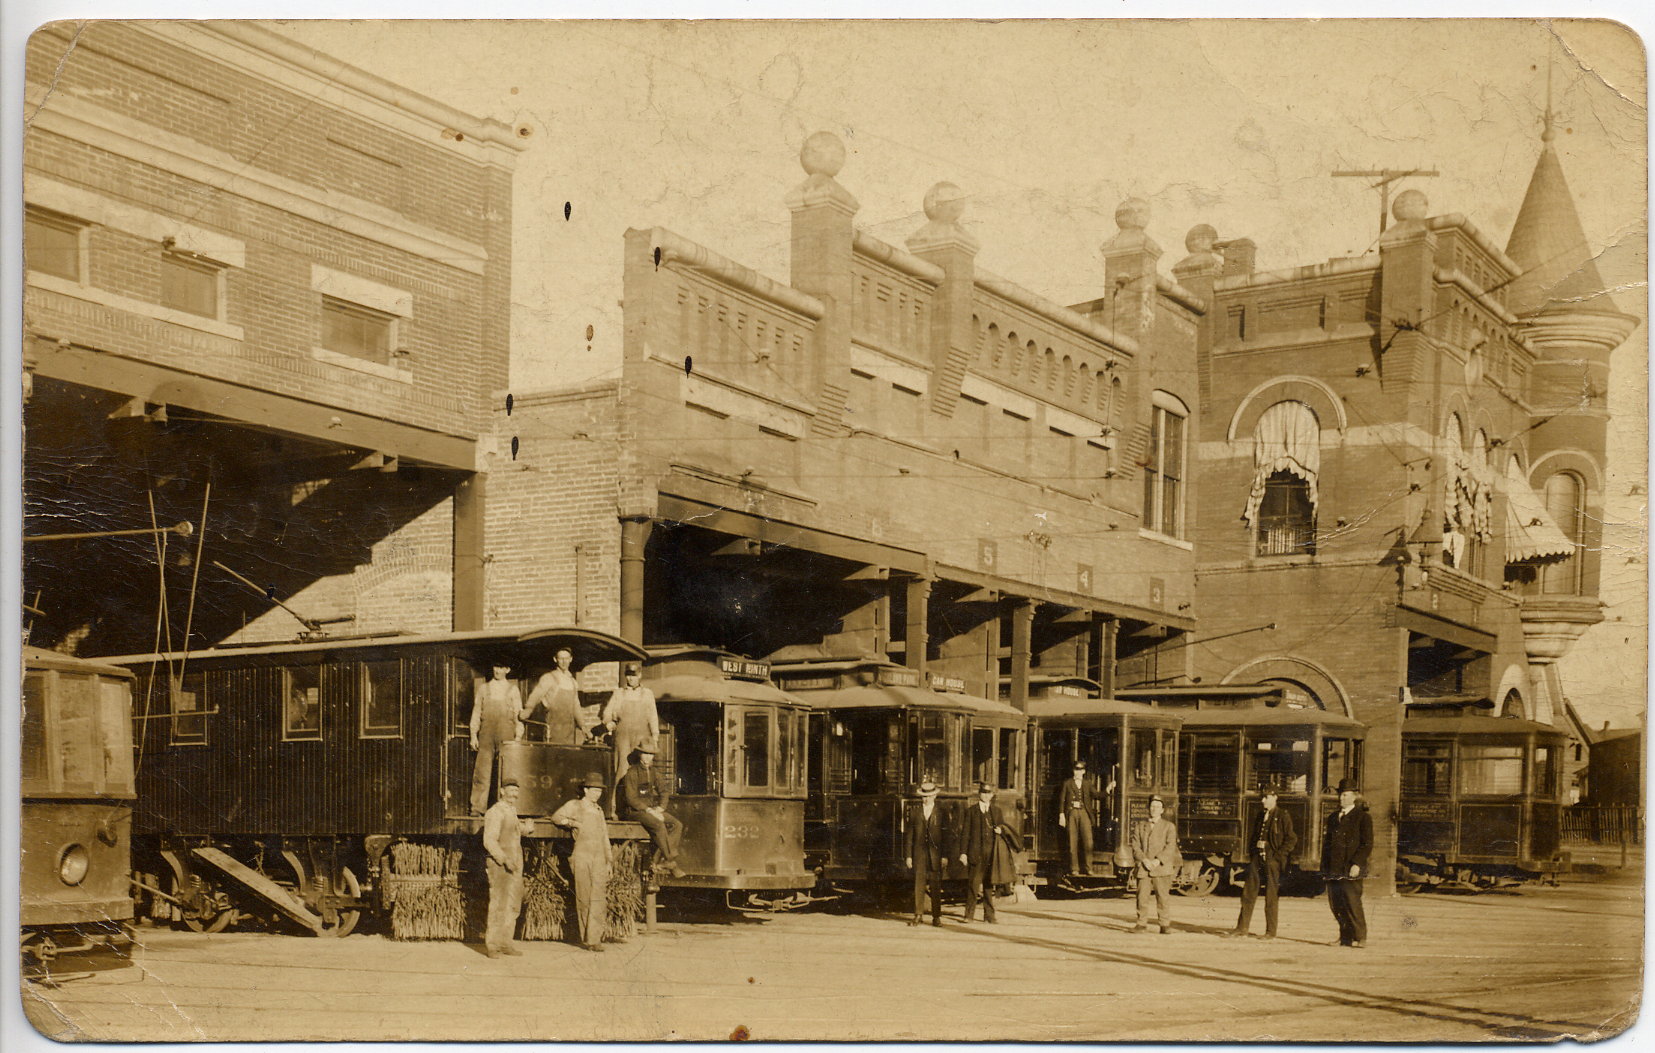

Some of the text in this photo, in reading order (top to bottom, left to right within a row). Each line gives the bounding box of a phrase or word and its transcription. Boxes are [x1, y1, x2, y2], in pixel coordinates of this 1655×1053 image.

[983, 547, 994, 566] 5
[1080, 569, 1090, 589] 4
[1153, 586, 1161, 603] 3
[722, 660, 769, 676] WEST NINTH
[724, 825, 760, 839] 232
